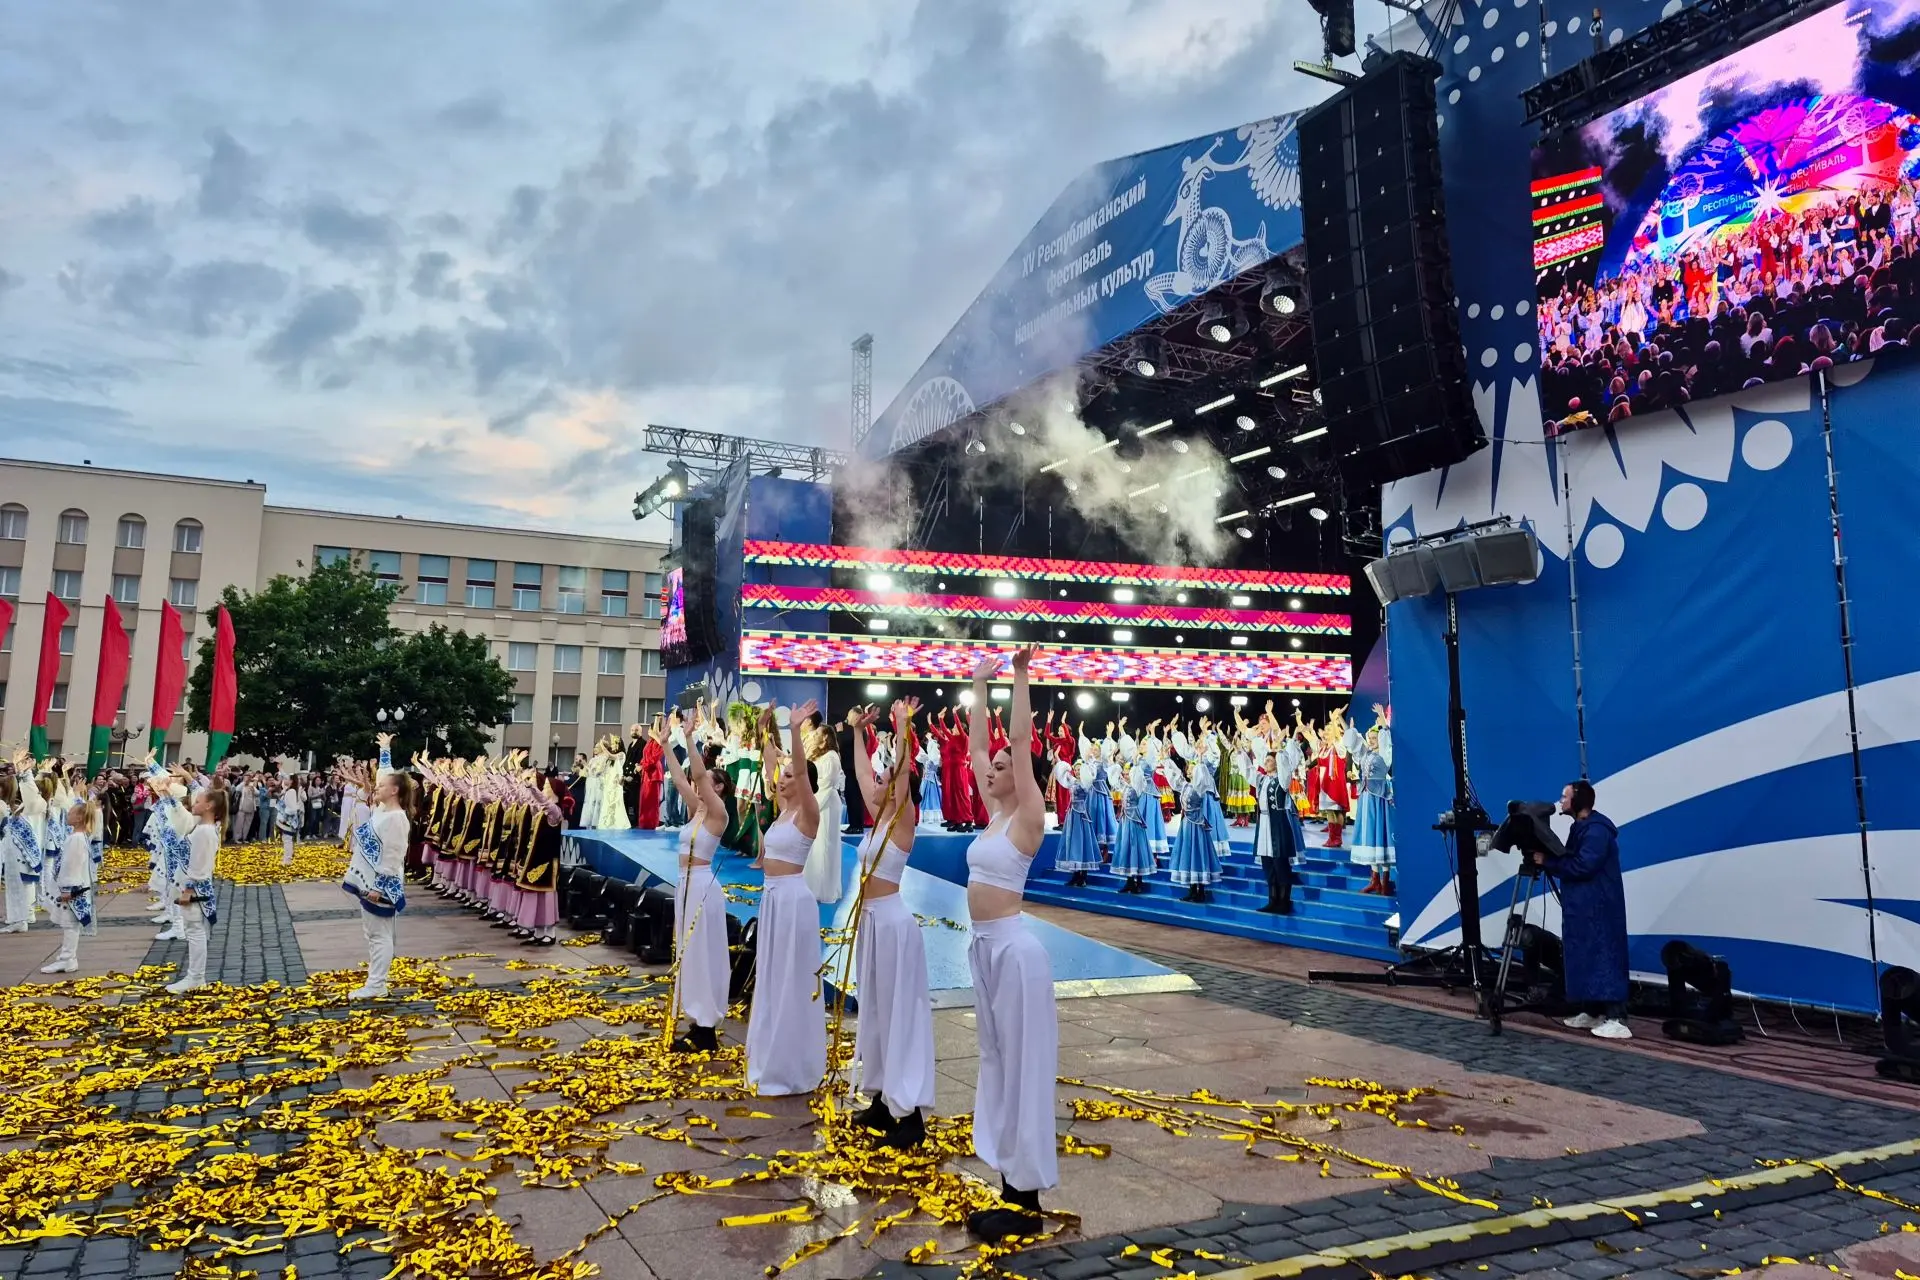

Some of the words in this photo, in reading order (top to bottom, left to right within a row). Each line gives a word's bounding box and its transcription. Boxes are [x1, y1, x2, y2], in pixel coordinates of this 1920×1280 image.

[1790, 153, 1847, 181] ФЕСТИВАЛЬ
[1037, 174, 1147, 269] Республиканский
[1046, 239, 1113, 298] фестиваль
[1100, 248, 1155, 298] культур
